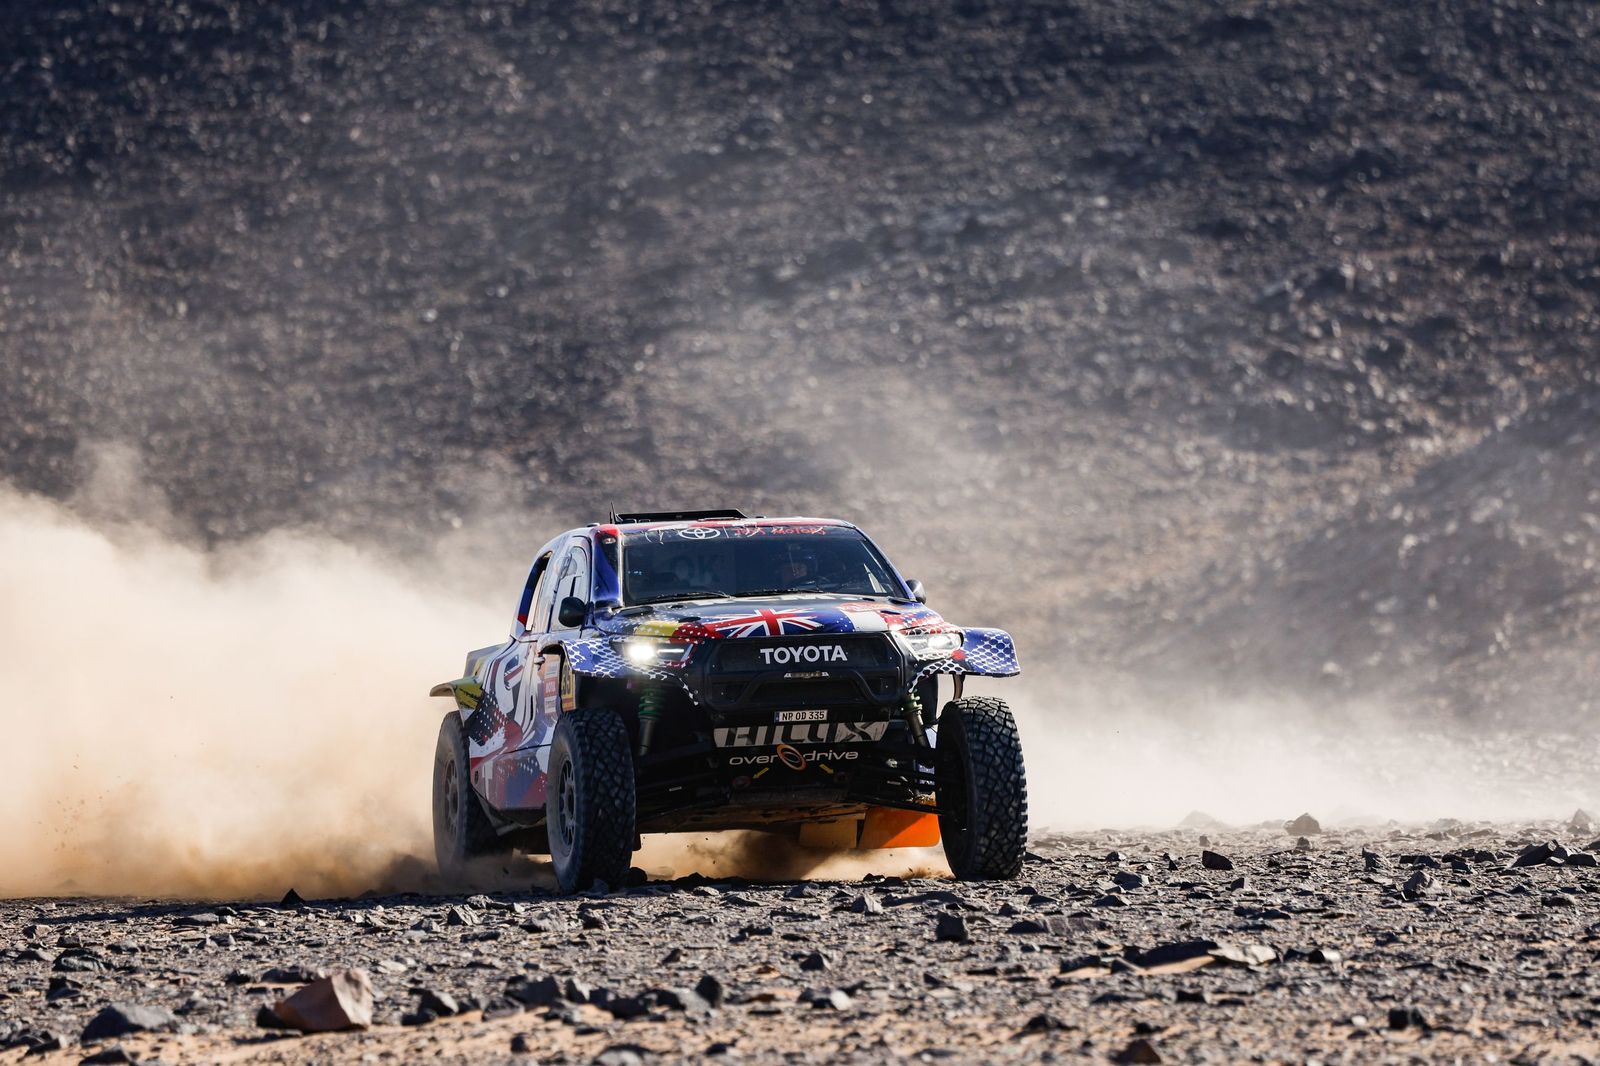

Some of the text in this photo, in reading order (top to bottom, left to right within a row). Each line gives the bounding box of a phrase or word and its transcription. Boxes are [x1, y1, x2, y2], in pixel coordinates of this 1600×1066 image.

[760, 645, 848, 665] TOYOTA
[808, 711, 825, 720] 335
[729, 750, 859, 766] over drive
